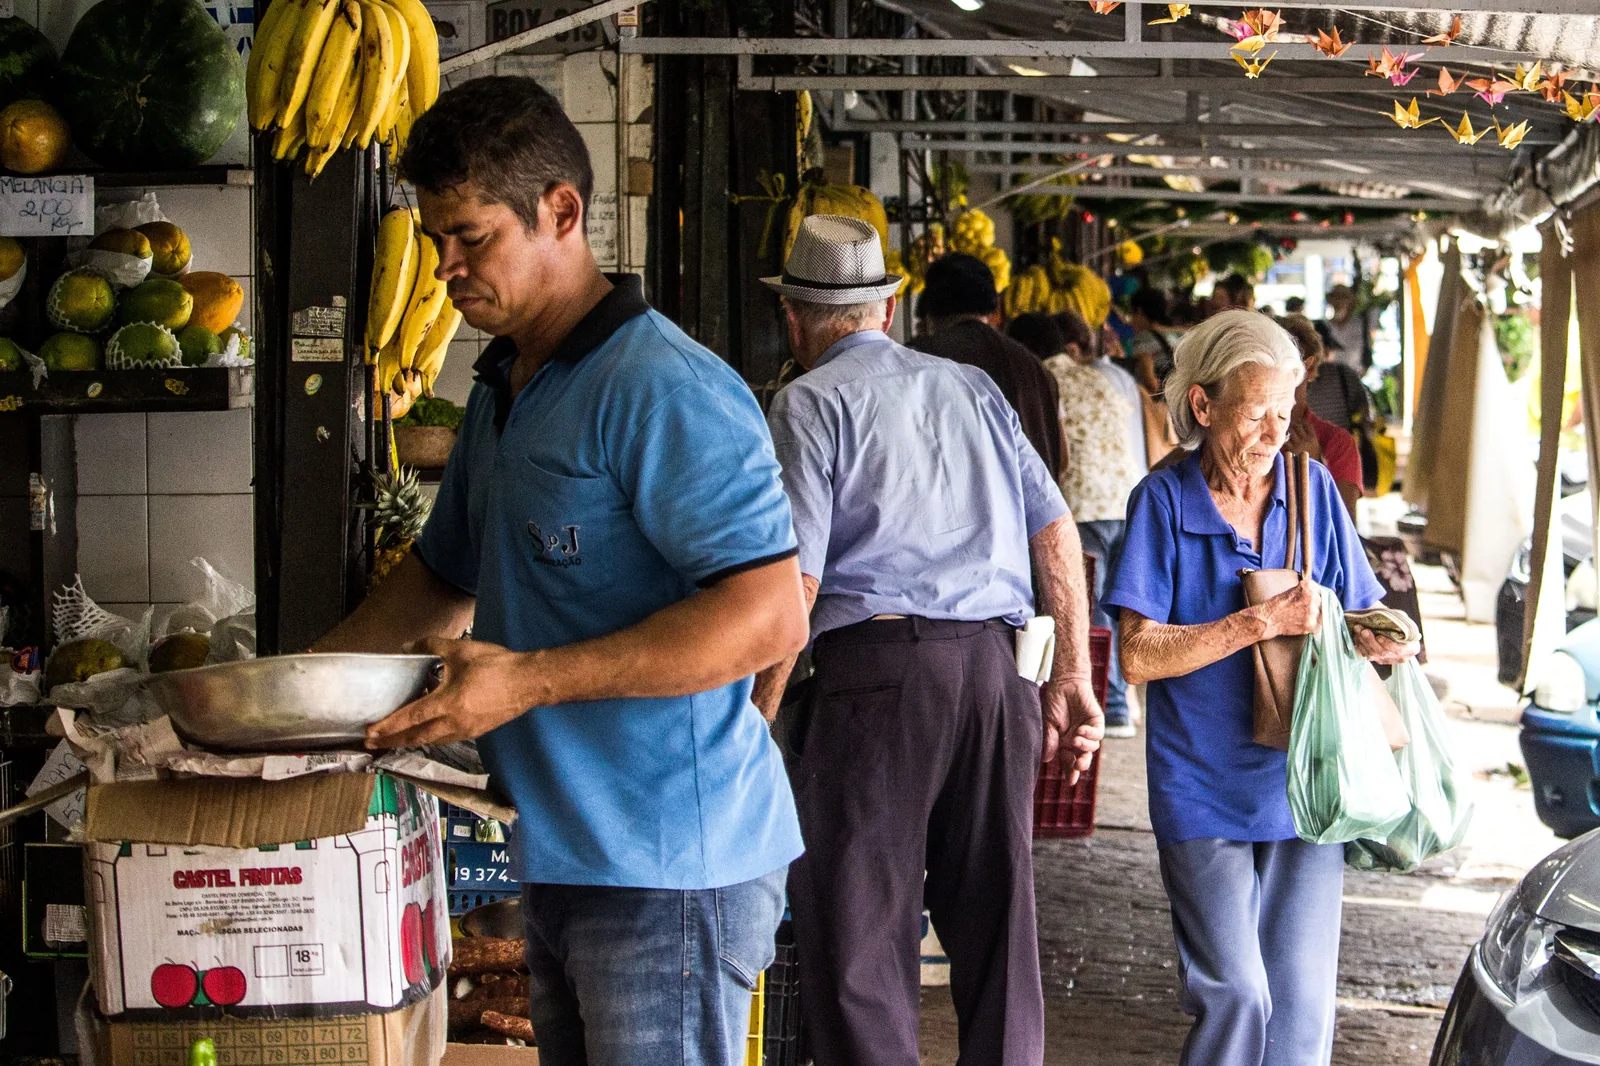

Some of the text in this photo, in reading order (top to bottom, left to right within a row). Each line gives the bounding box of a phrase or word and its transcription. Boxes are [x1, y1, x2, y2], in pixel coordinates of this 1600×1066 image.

[0, 177, 84, 194] MELANCIA
[19, 198, 73, 223] 2,00
[173, 867, 302, 889] CASTEL FRUTAS
[475, 868, 518, 883] 374
[243, 925, 304, 934] SELECIONADAS
[295, 949, 311, 963] 18
[265, 1030, 283, 1043] 69
[293, 1029, 309, 1042] 70
[320, 1028, 336, 1041] 71
[346, 1027, 362, 1040] 72
[241, 1049, 257, 1063] 77
[267, 1048, 284, 1062] 78
[294, 1047, 311, 1061] 79
[320, 1046, 337, 1060] 80
[347, 1046, 363, 1059] 81
